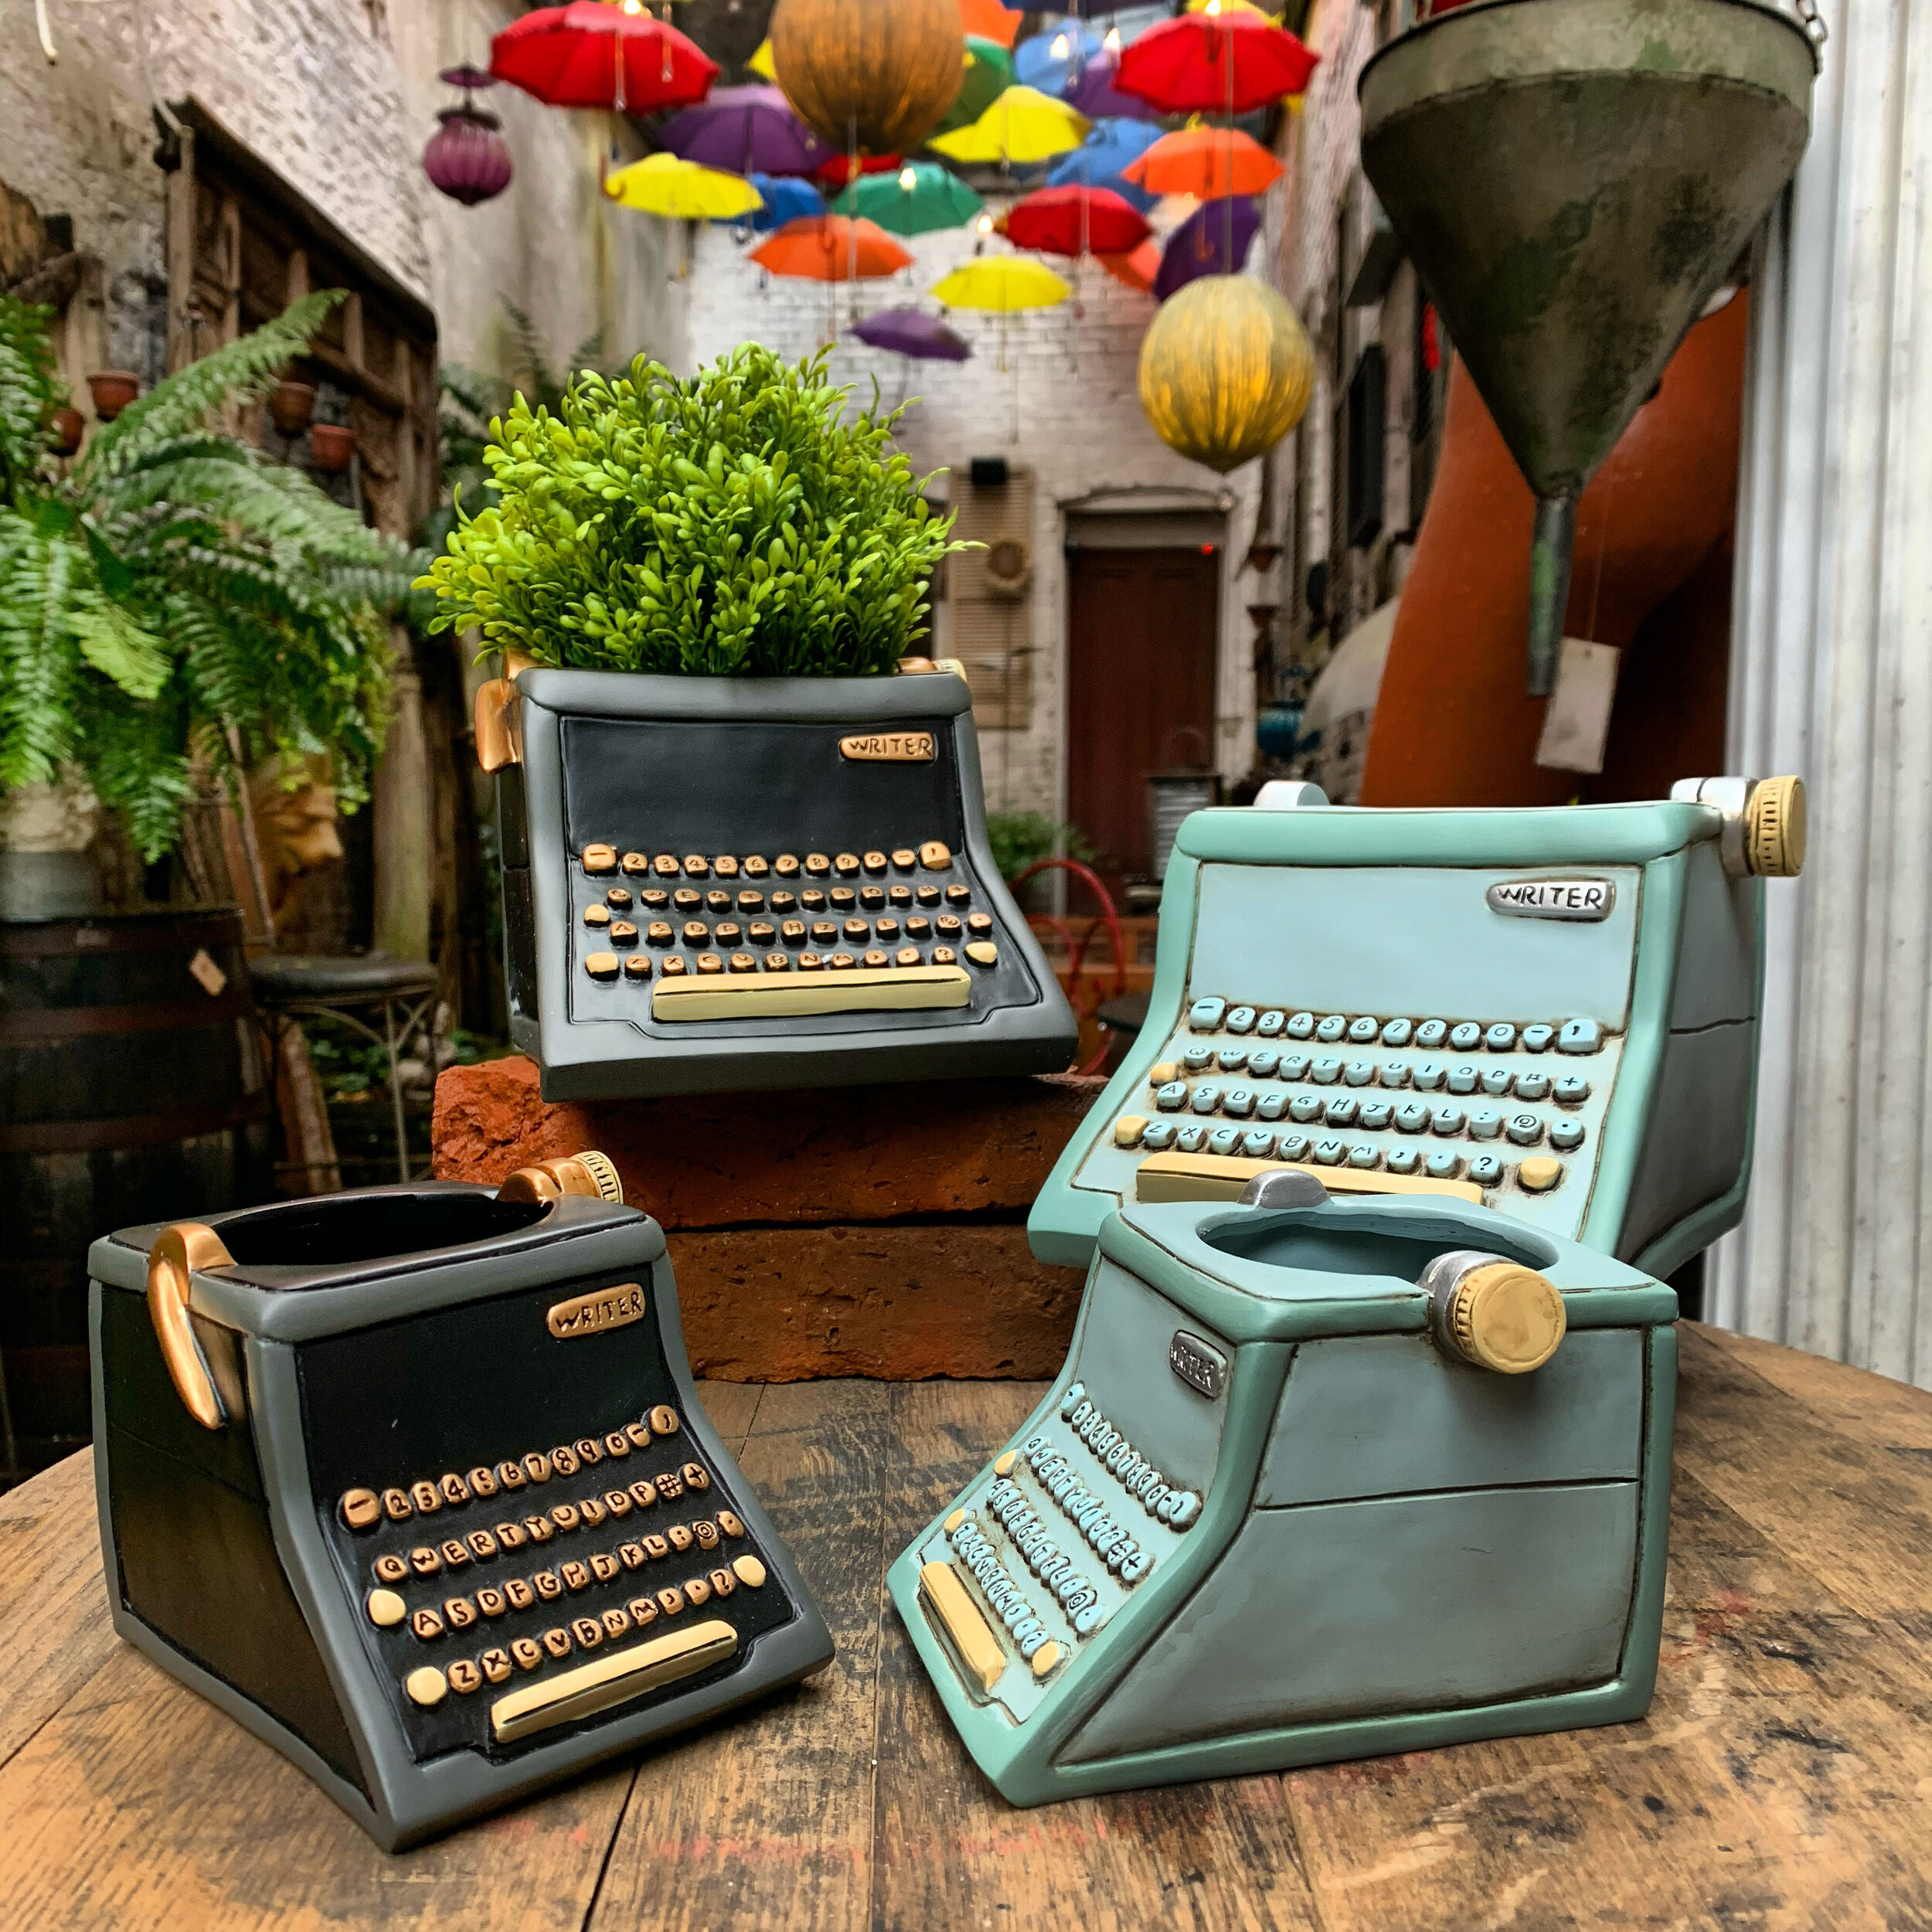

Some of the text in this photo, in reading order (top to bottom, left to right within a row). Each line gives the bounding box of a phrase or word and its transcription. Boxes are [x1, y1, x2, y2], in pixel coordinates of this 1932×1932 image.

[849, 737, 932, 757] WRITER
[1497, 886, 1604, 910] WRITER
[1235, 1010, 1509, 1037] 2 3 4 5 6 7 8 9 0
[1253, 1053, 1268, 1061] E
[1459, 1066, 1472, 1075] O
[1563, 1077, 1577, 1086] +
[1162, 1085, 1175, 1094] A
[1199, 1088, 1213, 1097] S
[1232, 1091, 1246, 1100] D
[1264, 1095, 1278, 1104] F
[1298, 1097, 1311, 1105] G
[1332, 1099, 1349, 1111] H
[1404, 1105, 1418, 1114] K
[1442, 1109, 1450, 1117] L
[1513, 1114, 1537, 1128] @
[1182, 1128, 1197, 1138] X
[1216, 1130, 1230, 1138] C
[1284, 1136, 1301, 1147] B
[1319, 1141, 1338, 1151] N
[1480, 1157, 1492, 1170] ?
[556, 1291, 643, 1329] WRITER
[391, 1437, 622, 1512] 2 3 4 5 6 7 8 9 0
[385, 1559, 401, 1572] Q
[413, 1551, 434, 1565] W
[446, 1544, 464, 1560] E
[473, 1534, 490, 1551] R
[500, 1526, 515, 1542] T
[526, 1519, 544, 1535] Y
[554, 1508, 572, 1521] U
[635, 1485, 647, 1500] P
[659, 1475, 680, 1492] #
[689, 1467, 702, 1484] +
[420, 1614, 439, 1631] A
[452, 1604, 468, 1623] S
[483, 1593, 498, 1607] D
[512, 1583, 526, 1600] F
[540, 1576, 557, 1591] G
[597, 1557, 610, 1575] J
[624, 1547, 638, 1563] K
[648, 1539, 664, 1549] L
[696, 1522, 715, 1539] @
[455, 1665, 474, 1683] Z
[485, 1653, 510, 1671] X
[519, 1643, 535, 1657] C
[552, 1633, 564, 1647] V
[578, 1621, 595, 1642] B
[607, 1614, 624, 1628] N
[634, 1602, 656, 1615] M
